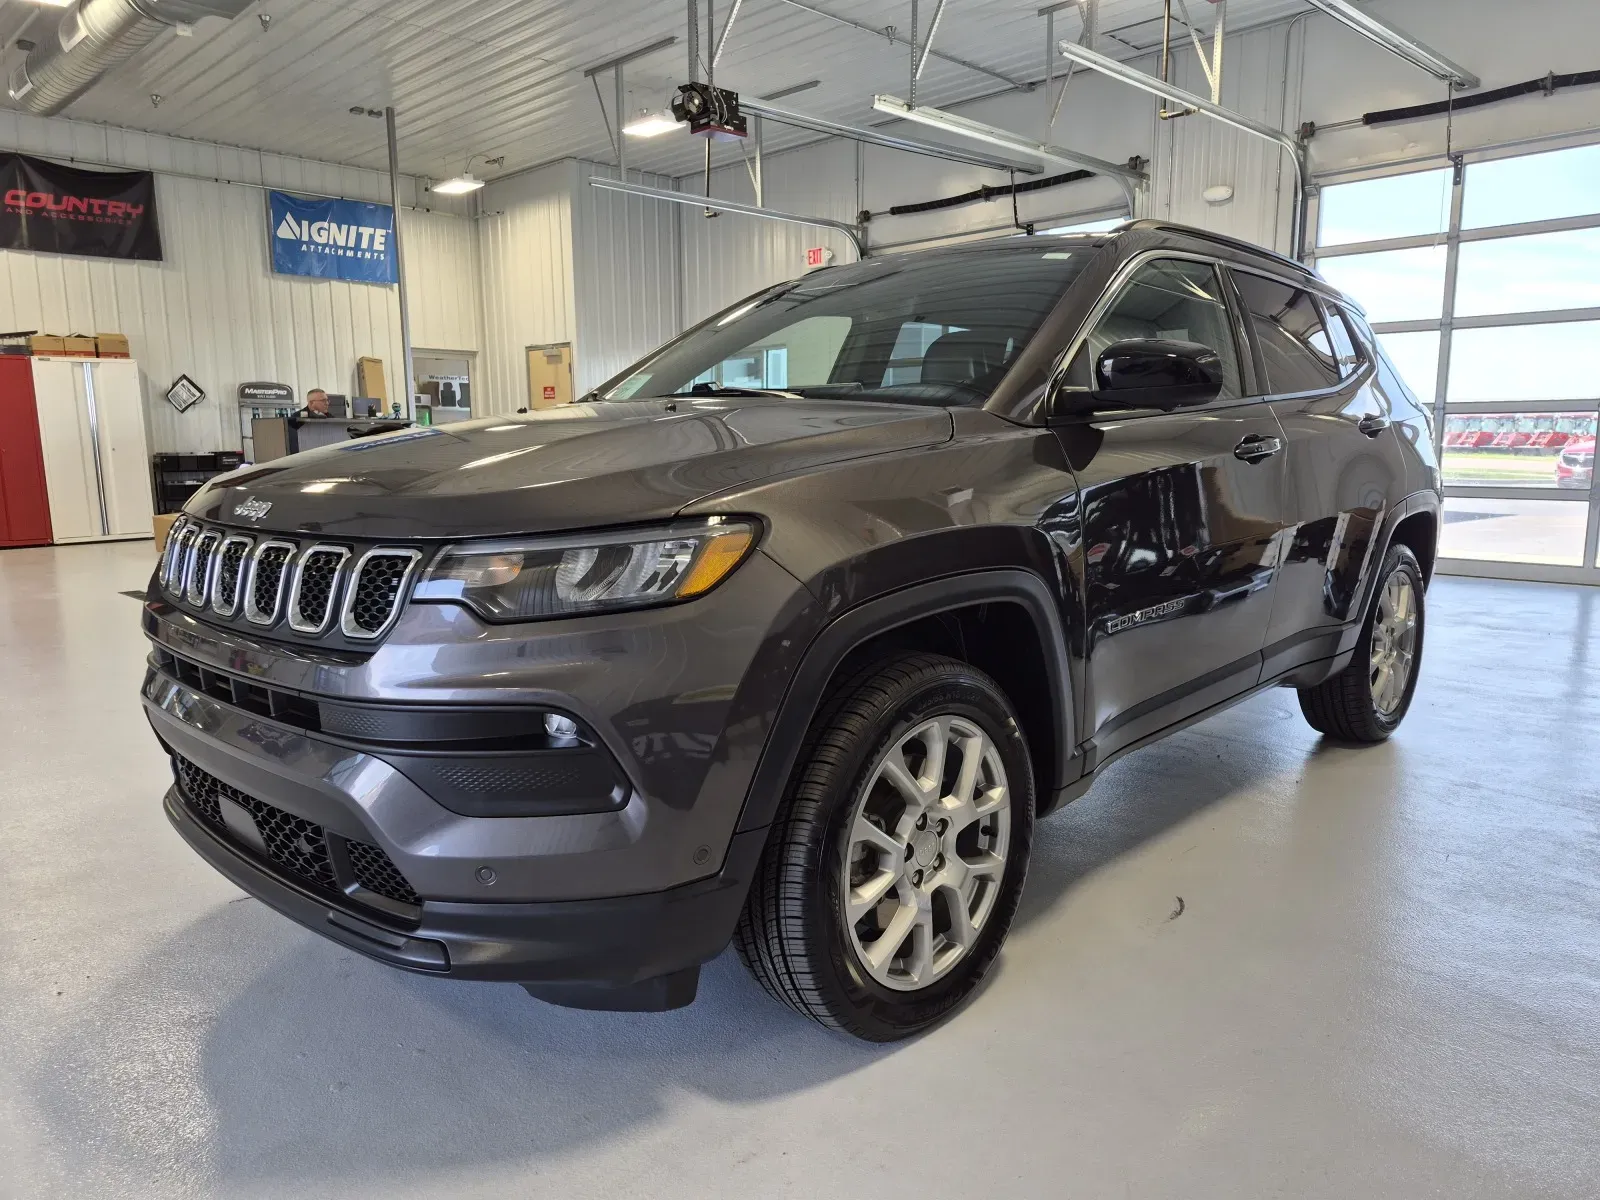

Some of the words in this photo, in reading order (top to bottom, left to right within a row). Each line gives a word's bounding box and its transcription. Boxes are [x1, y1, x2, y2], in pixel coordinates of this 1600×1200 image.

[5, 190, 143, 218] COUNTRY
[6, 207, 33, 216] AND
[41, 211, 133, 226] ACCESSORIES
[301, 220, 386, 251] IGNITE
[301, 244, 385, 260] ATTACHMENTS
[808, 248, 822, 265] EXIT
[234, 496, 272, 521] Jeep
[1105, 599, 1185, 633] COMPASS
